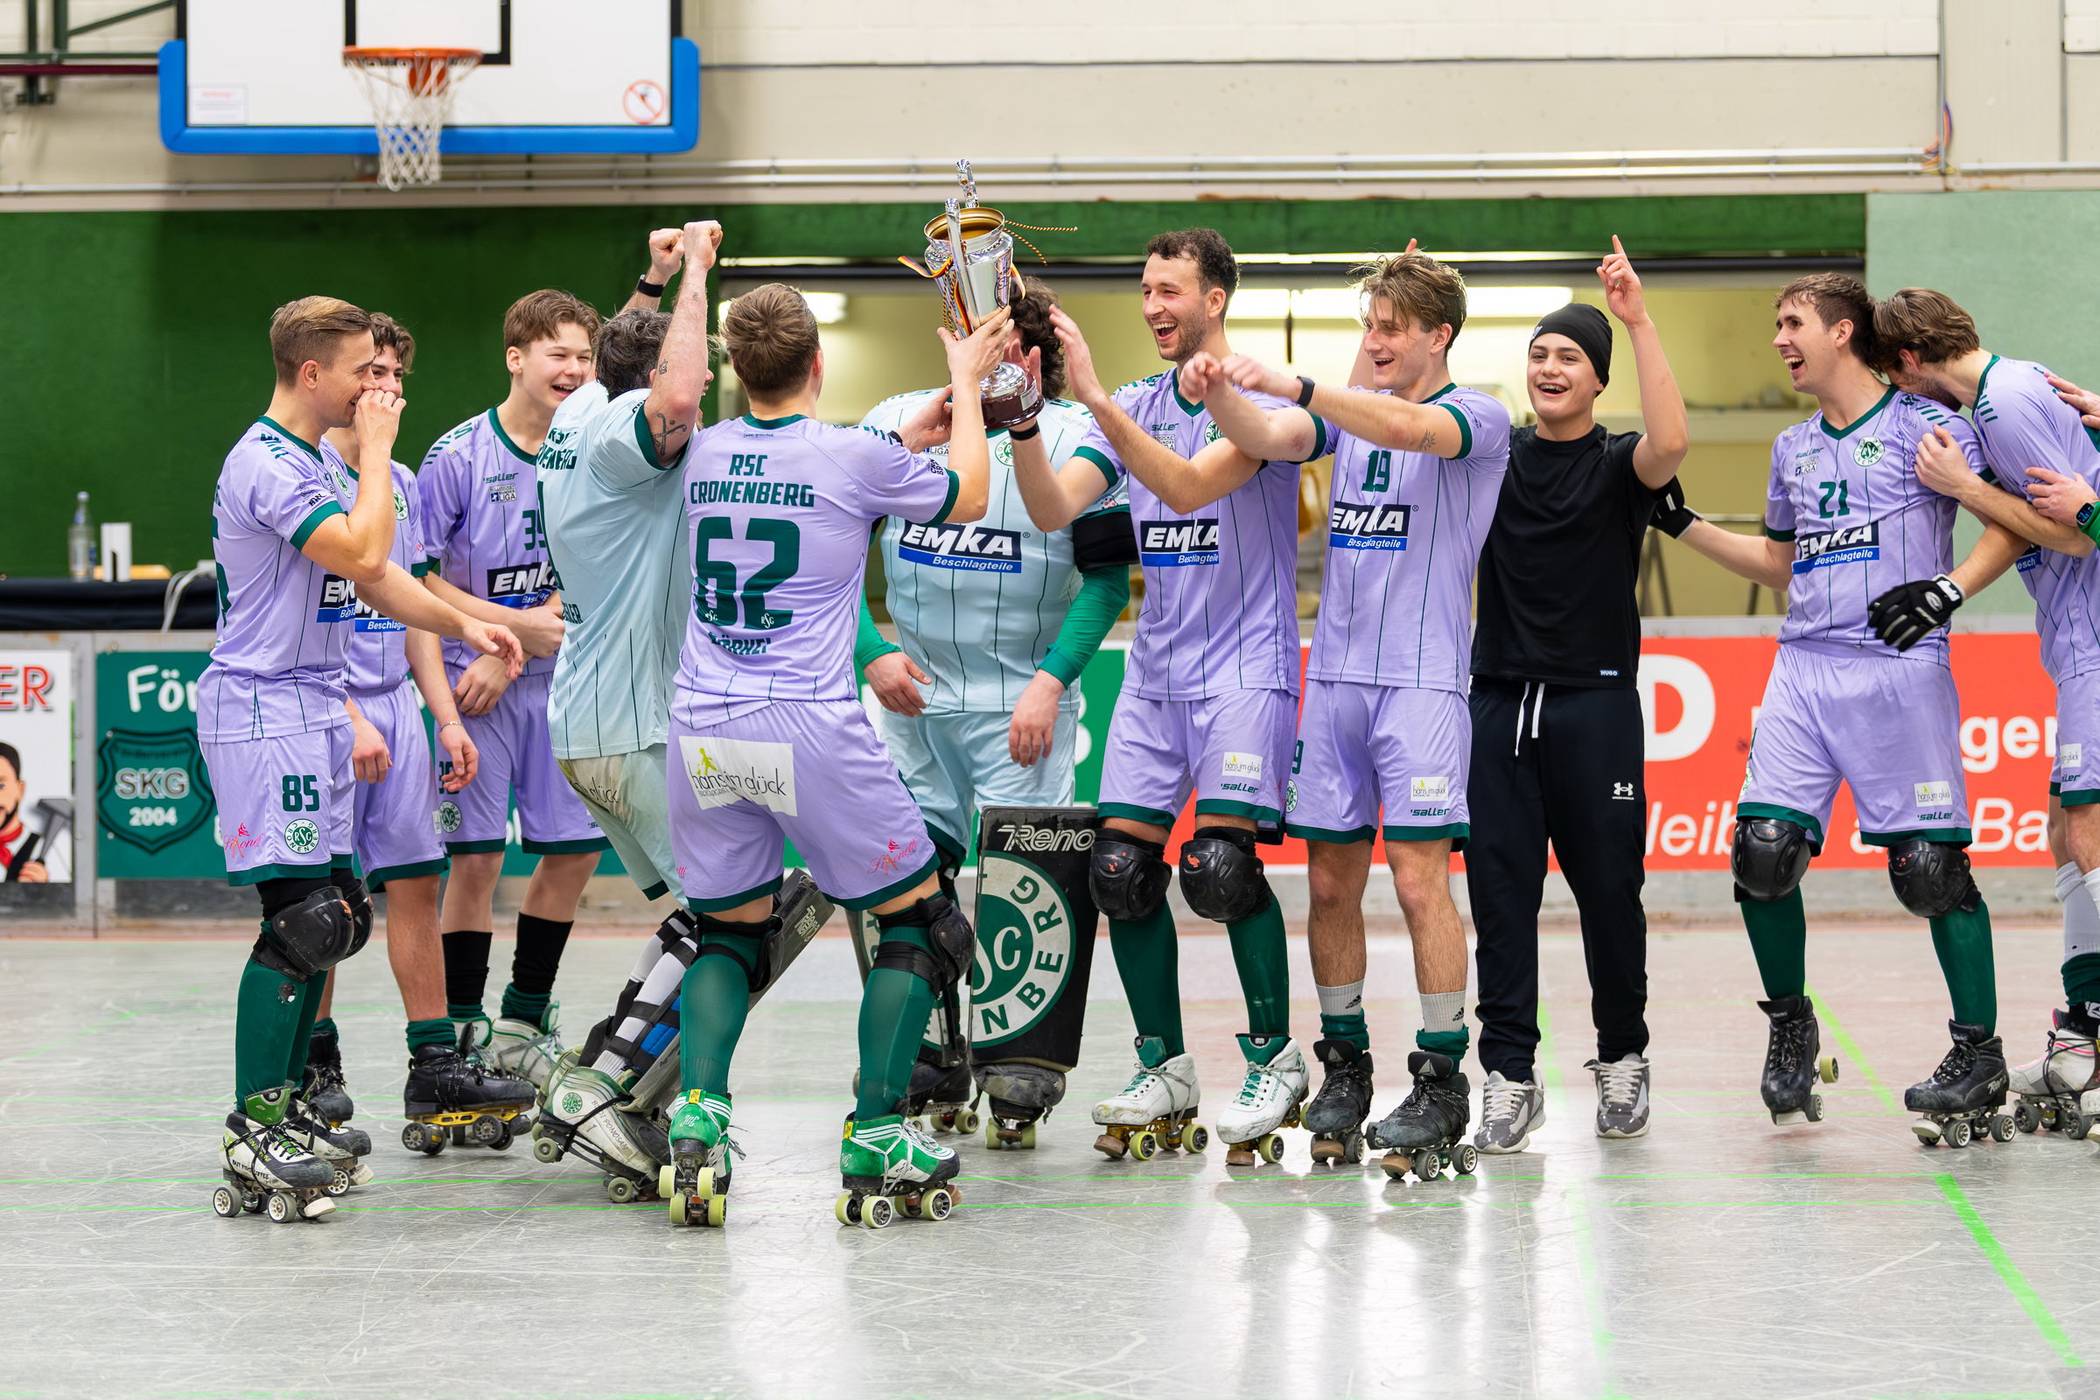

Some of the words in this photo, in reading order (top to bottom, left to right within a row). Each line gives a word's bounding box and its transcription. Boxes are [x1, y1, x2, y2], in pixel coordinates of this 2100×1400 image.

[729, 454, 768, 476] RSC
[1361, 450, 1392, 493] 19
[690, 480, 815, 507] CRONENBERG
[1819, 480, 1850, 519] 21
[903, 522, 1013, 556] EMKA
[1145, 519, 1219, 553] EMKA
[696, 516, 800, 631] 62
[932, 556, 1014, 572] Beschlagteile
[367, 620, 404, 631] Beschlag
[114, 767, 190, 800] SKG
[282, 774, 320, 812] 85
[1220, 783, 1260, 794] saller
[128, 806, 178, 827] 2004
[1410, 807, 1451, 817] saller
[997, 825, 1096, 852] Reno
